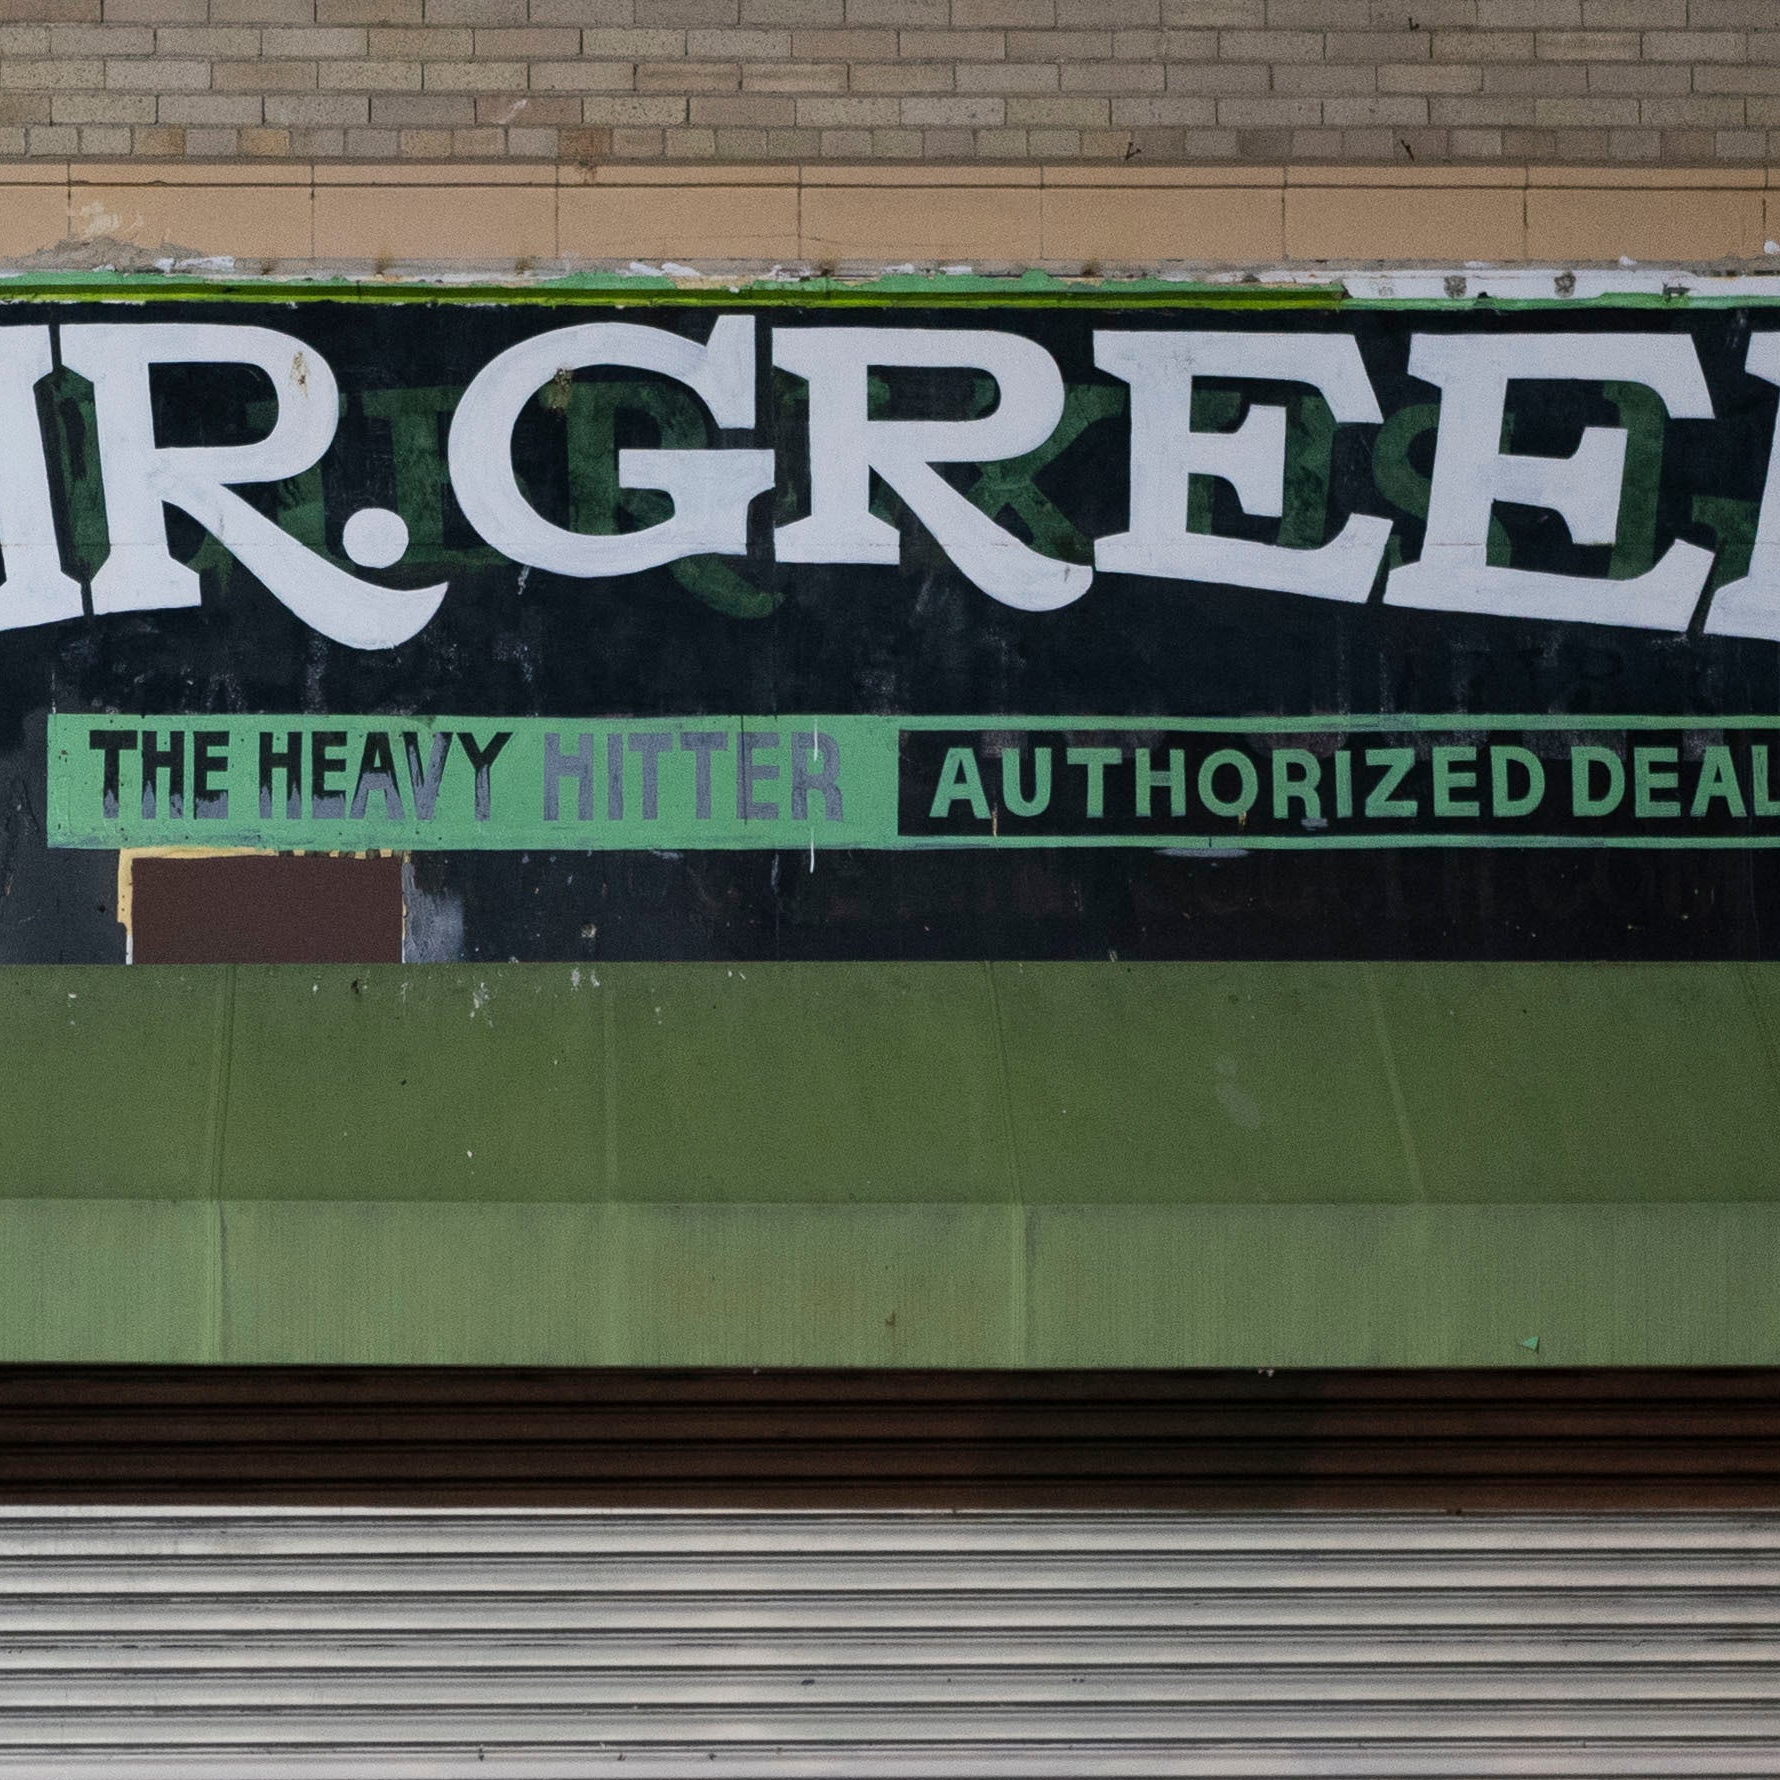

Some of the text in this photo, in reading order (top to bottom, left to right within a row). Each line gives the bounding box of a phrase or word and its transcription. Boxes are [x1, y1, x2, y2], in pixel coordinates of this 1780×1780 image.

[89, 730, 229, 819] THE
[259, 731, 512, 821] HEAVY
[544, 732, 843, 821] HITTER
[929, 746, 1546, 819] AUTHORIZED
